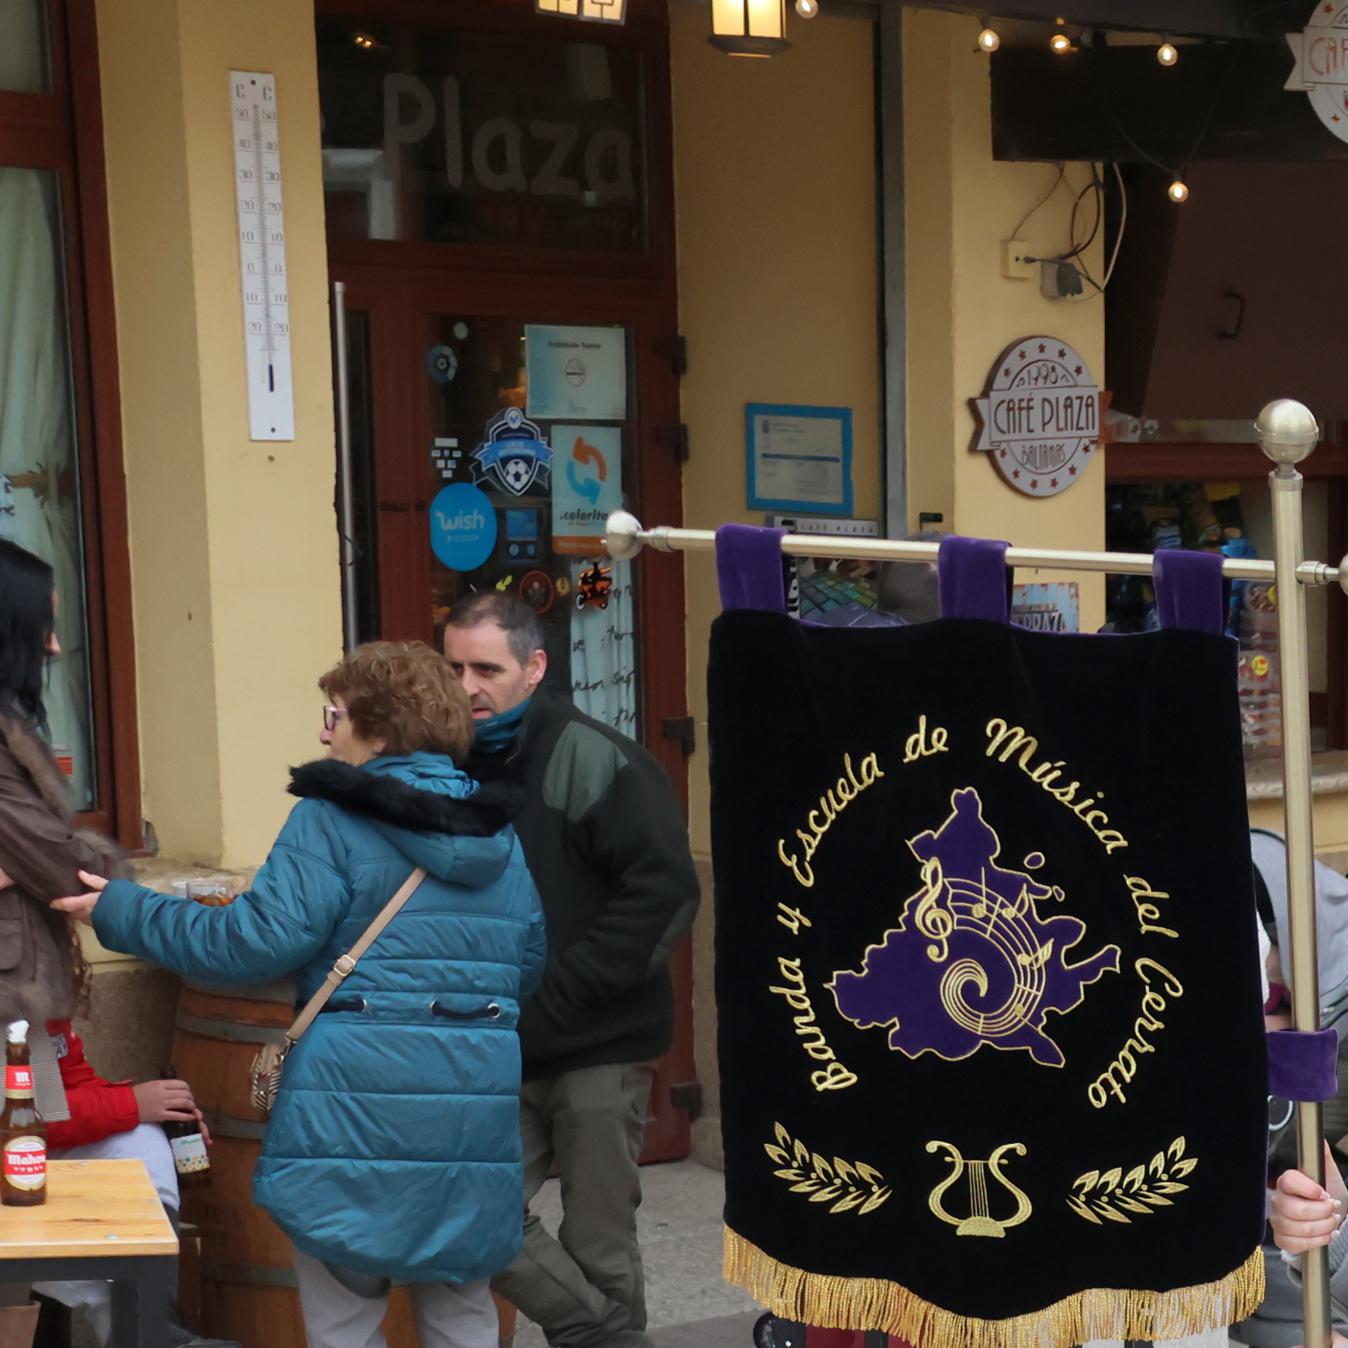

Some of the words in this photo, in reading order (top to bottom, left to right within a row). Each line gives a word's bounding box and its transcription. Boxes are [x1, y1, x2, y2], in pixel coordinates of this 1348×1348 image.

[383, 73, 638, 201] Plaza
[239, 170, 253, 180] 30
[265, 171, 279, 182] 30
[994, 392, 1034, 434] CAFÉ
[1041, 394, 1095, 432] PLAZA
[435, 508, 486, 530] wish
[903, 714, 949, 763] de
[985, 718, 1129, 855] Música
[778, 752, 885, 888] Escuela
[777, 902, 812, 935] y
[1124, 876, 1179, 938] del
[769, 956, 858, 1092] Banda
[1087, 957, 1184, 1109] Cerrato
